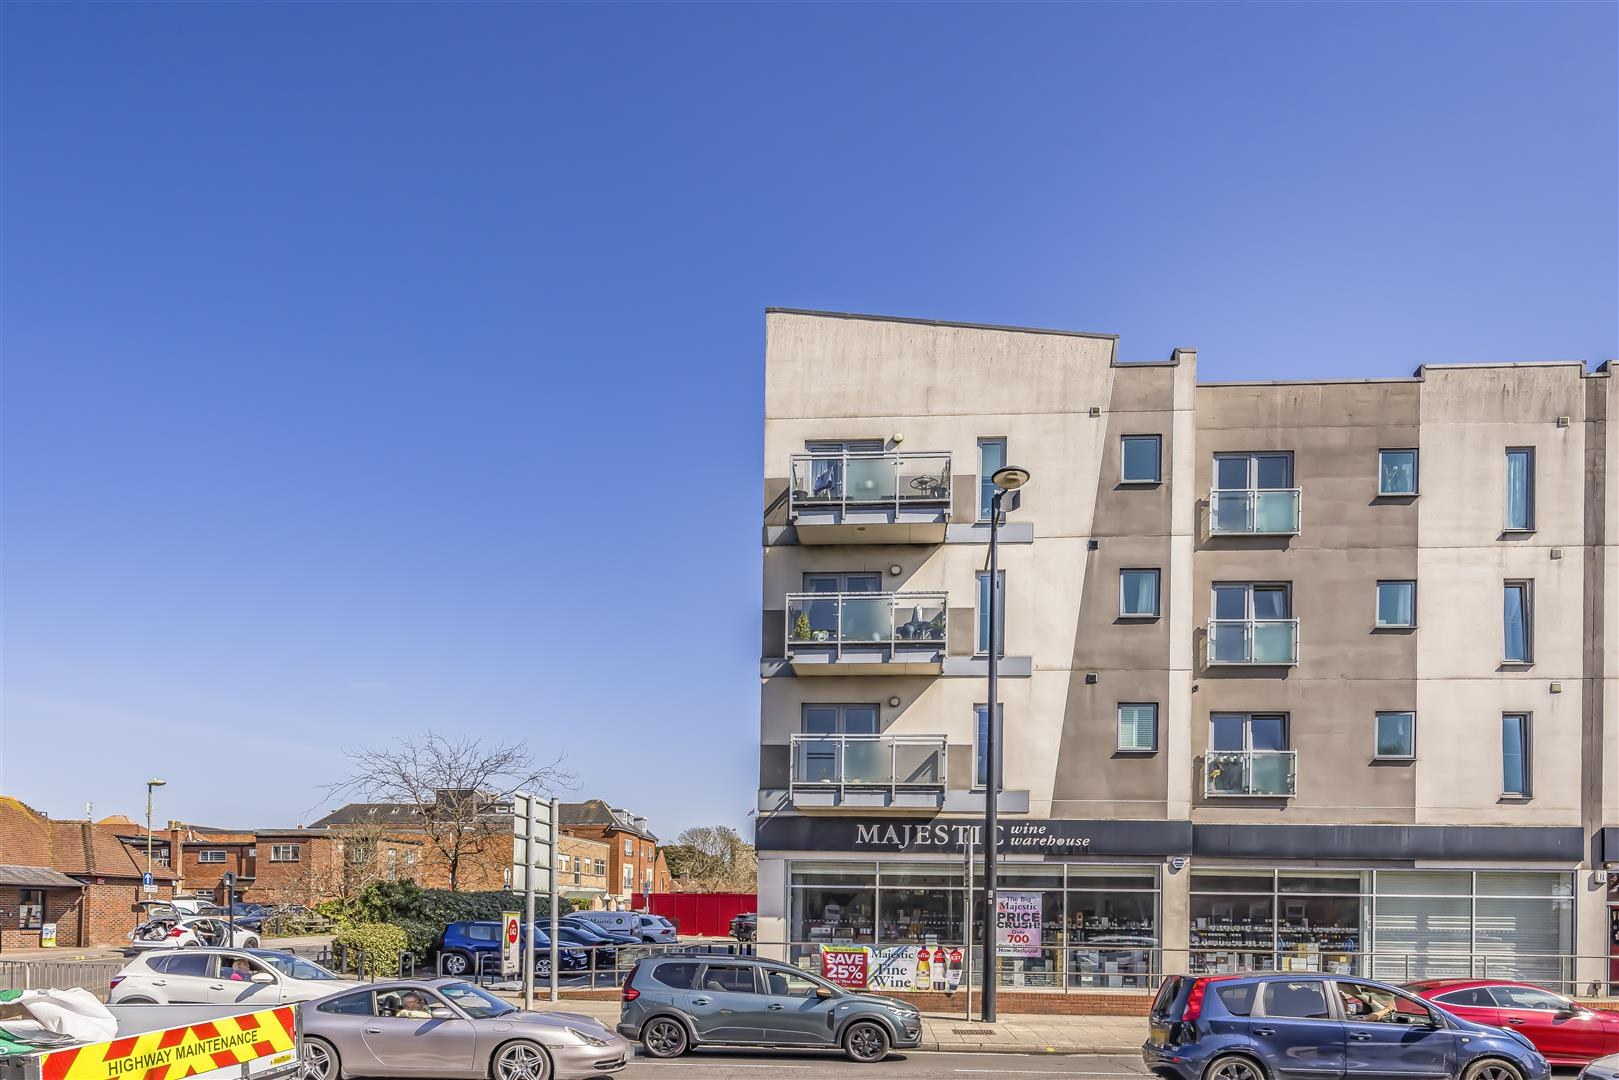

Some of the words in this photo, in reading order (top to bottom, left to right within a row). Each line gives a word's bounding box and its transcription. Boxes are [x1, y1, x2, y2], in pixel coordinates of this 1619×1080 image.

[1010, 823, 1046, 835] wine
[1010, 834, 1091, 847] warehouse
[999, 902, 1038, 911] Majestic
[997, 912, 1040, 922] PRICE
[997, 921, 1040, 929] CRUSH!
[1007, 934, 1030, 943] 700
[826, 953, 864, 965] SAVE
[871, 949, 914, 961] Majestic
[826, 964, 864, 980] 25%
[878, 963, 907, 976] Fine
[873, 975, 912, 988] Wine
[108, 1049, 172, 1076] HIGHWAY
[175, 1030, 258, 1060] MAINTENANCE
